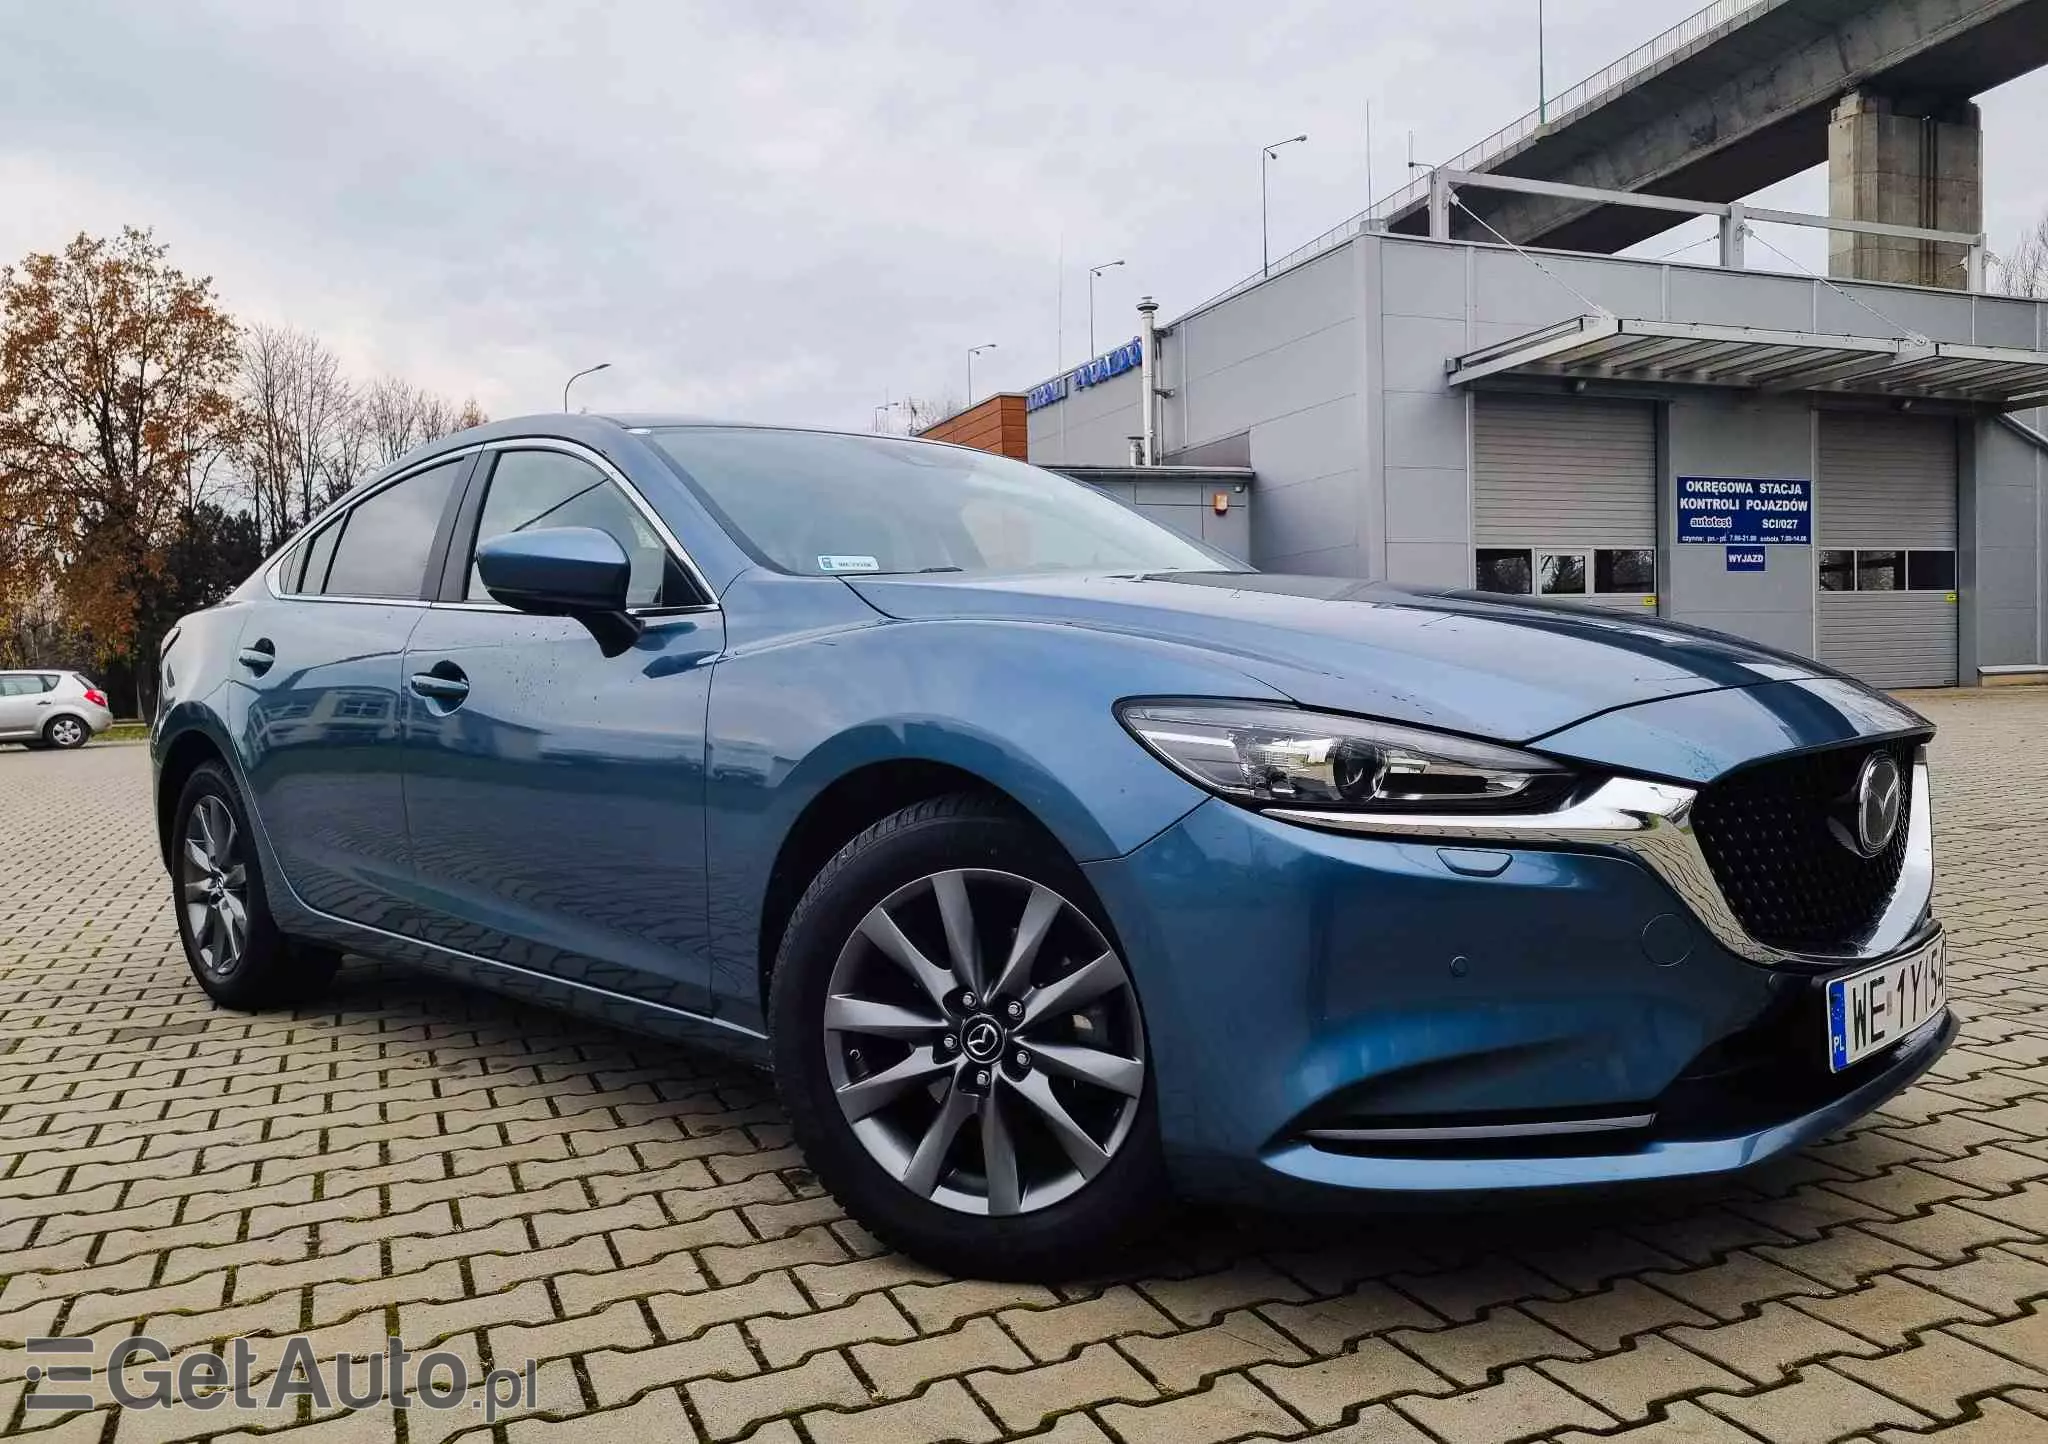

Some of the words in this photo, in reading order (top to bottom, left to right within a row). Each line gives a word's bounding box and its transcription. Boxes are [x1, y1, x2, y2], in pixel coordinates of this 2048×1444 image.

[1686, 481, 1753, 495] OKRĘGOWA
[1759, 483, 1802, 494] STACJA
[1680, 498, 1740, 510] KONTROLI
[1746, 498, 1808, 511] POJAZDÓW
[1690, 516, 1732, 528] autotest
[1762, 519, 1798, 529] SCI/027
[1728, 554, 1764, 563] WYJAZD
[1833, 1035, 1844, 1053] PL
